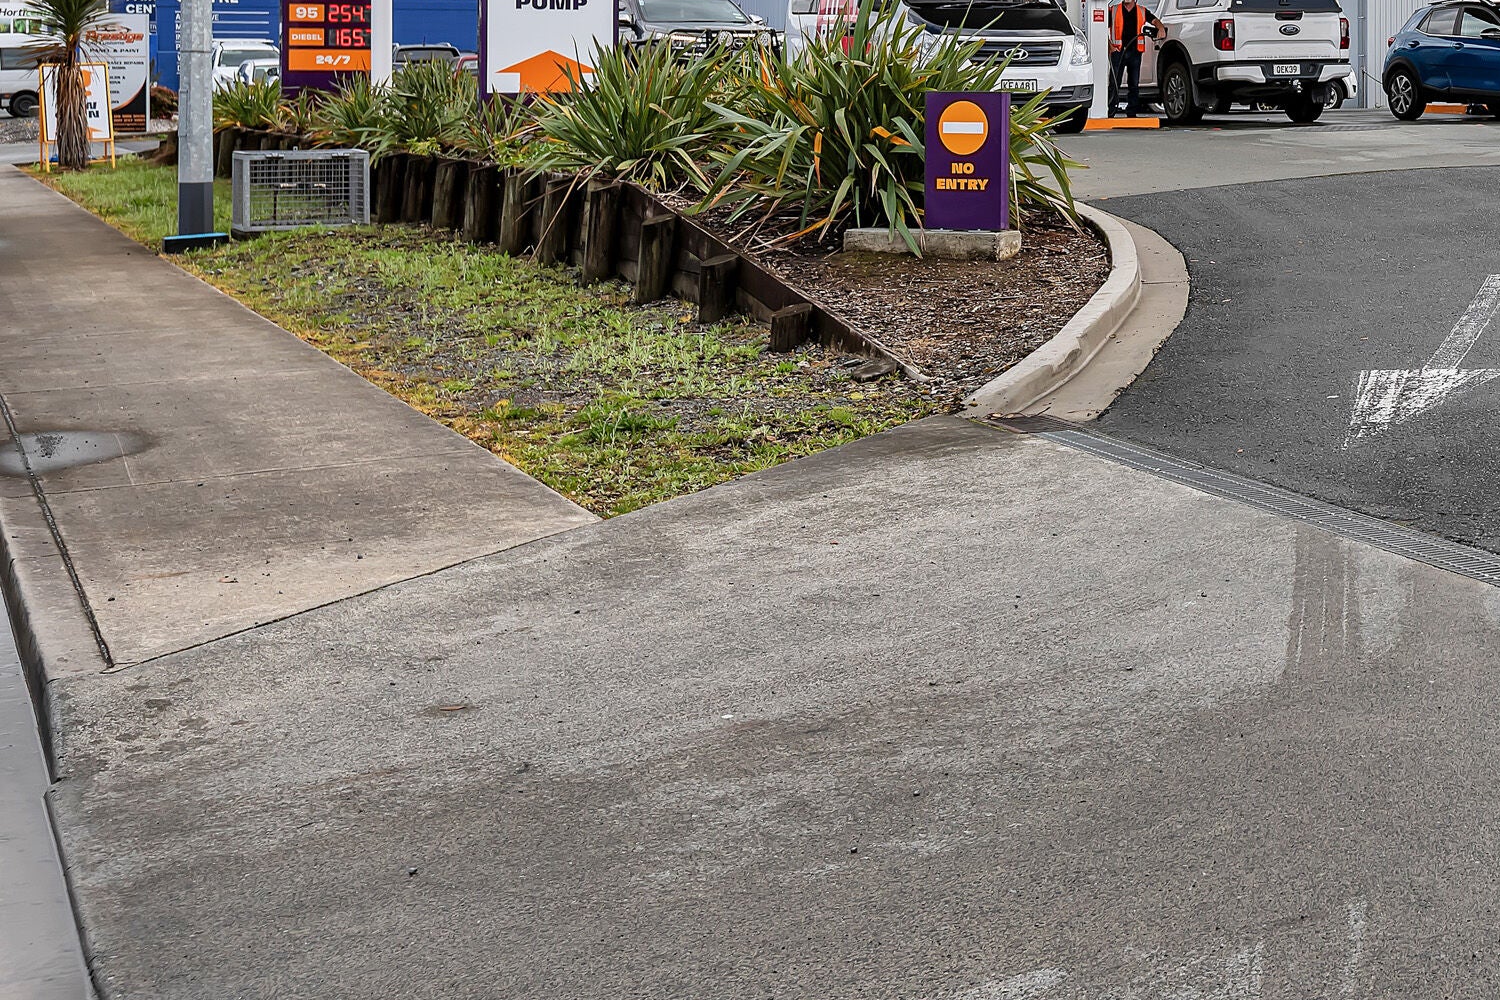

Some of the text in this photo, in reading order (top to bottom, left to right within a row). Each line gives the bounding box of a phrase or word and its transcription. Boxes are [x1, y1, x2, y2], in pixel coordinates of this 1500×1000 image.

[295, 7, 318, 19] 95
[291, 33, 322, 41] DIESEL
[315, 55, 350, 65] 24/7
[951, 162, 975, 175] NO
[936, 178, 989, 191] ENTRY
